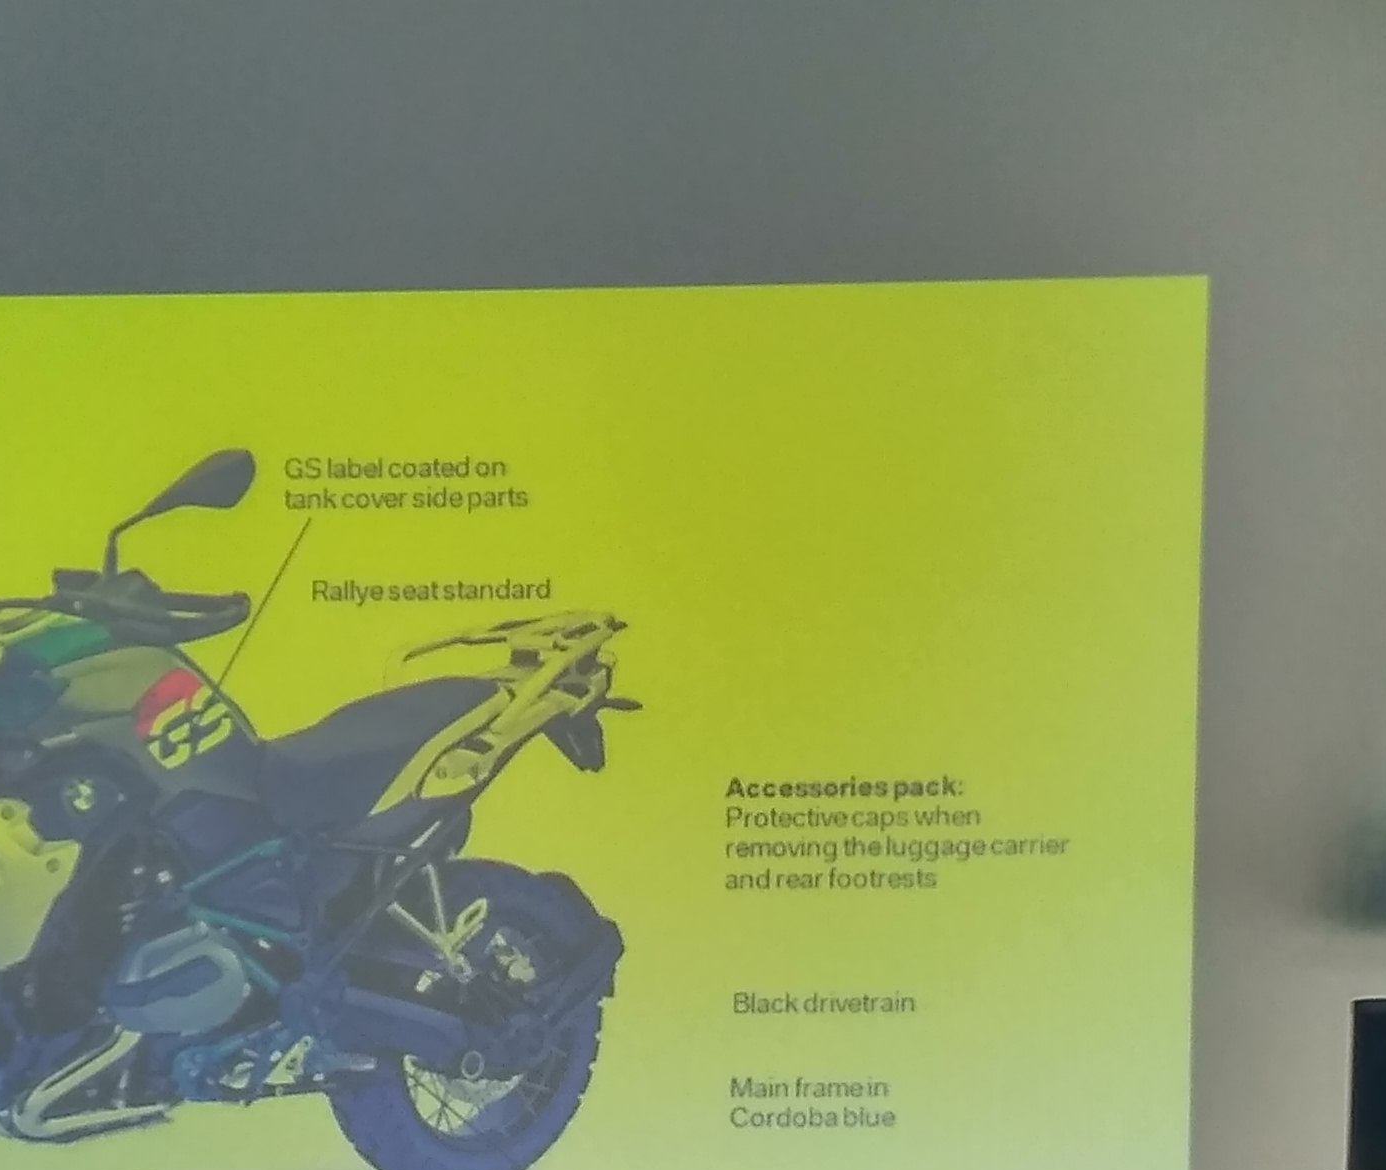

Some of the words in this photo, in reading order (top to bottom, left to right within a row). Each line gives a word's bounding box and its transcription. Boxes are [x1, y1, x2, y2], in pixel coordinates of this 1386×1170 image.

[284, 457, 322, 480] GS
[327, 456, 384, 479] label
[388, 456, 469, 479] coated
[474, 459, 508, 478] on
[284, 487, 337, 510] tank
[340, 491, 407, 509] cover
[411, 486, 463, 508] side
[467, 487, 530, 514] parts
[312, 579, 384, 607] Rallye
[388, 581, 439, 601] seat
[442, 577, 552, 600] standard
[725, 776, 888, 799] Accessories
[892, 775, 964, 802] pack:
[725, 805, 848, 829] Protective
[851, 808, 909, 832] caps
[913, 805, 982, 827] when
[725, 838, 838, 864] removing
[843, 836, 883, 858] the
[886, 835, 987, 863] luggage
[990, 834, 1070, 856] carrier
[725, 867, 771, 891] and
[775, 871, 824, 890] rear
[828, 867, 939, 889] footrests
[733, 991, 799, 1015] Black
[803, 990, 917, 1014] drivetrain
[730, 1077, 789, 1098] Main
[795, 1076, 864, 1098] frame
[867, 1077, 890, 1098] in
[730, 1106, 838, 1128] Cordoba
[843, 1106, 897, 1128] blue
